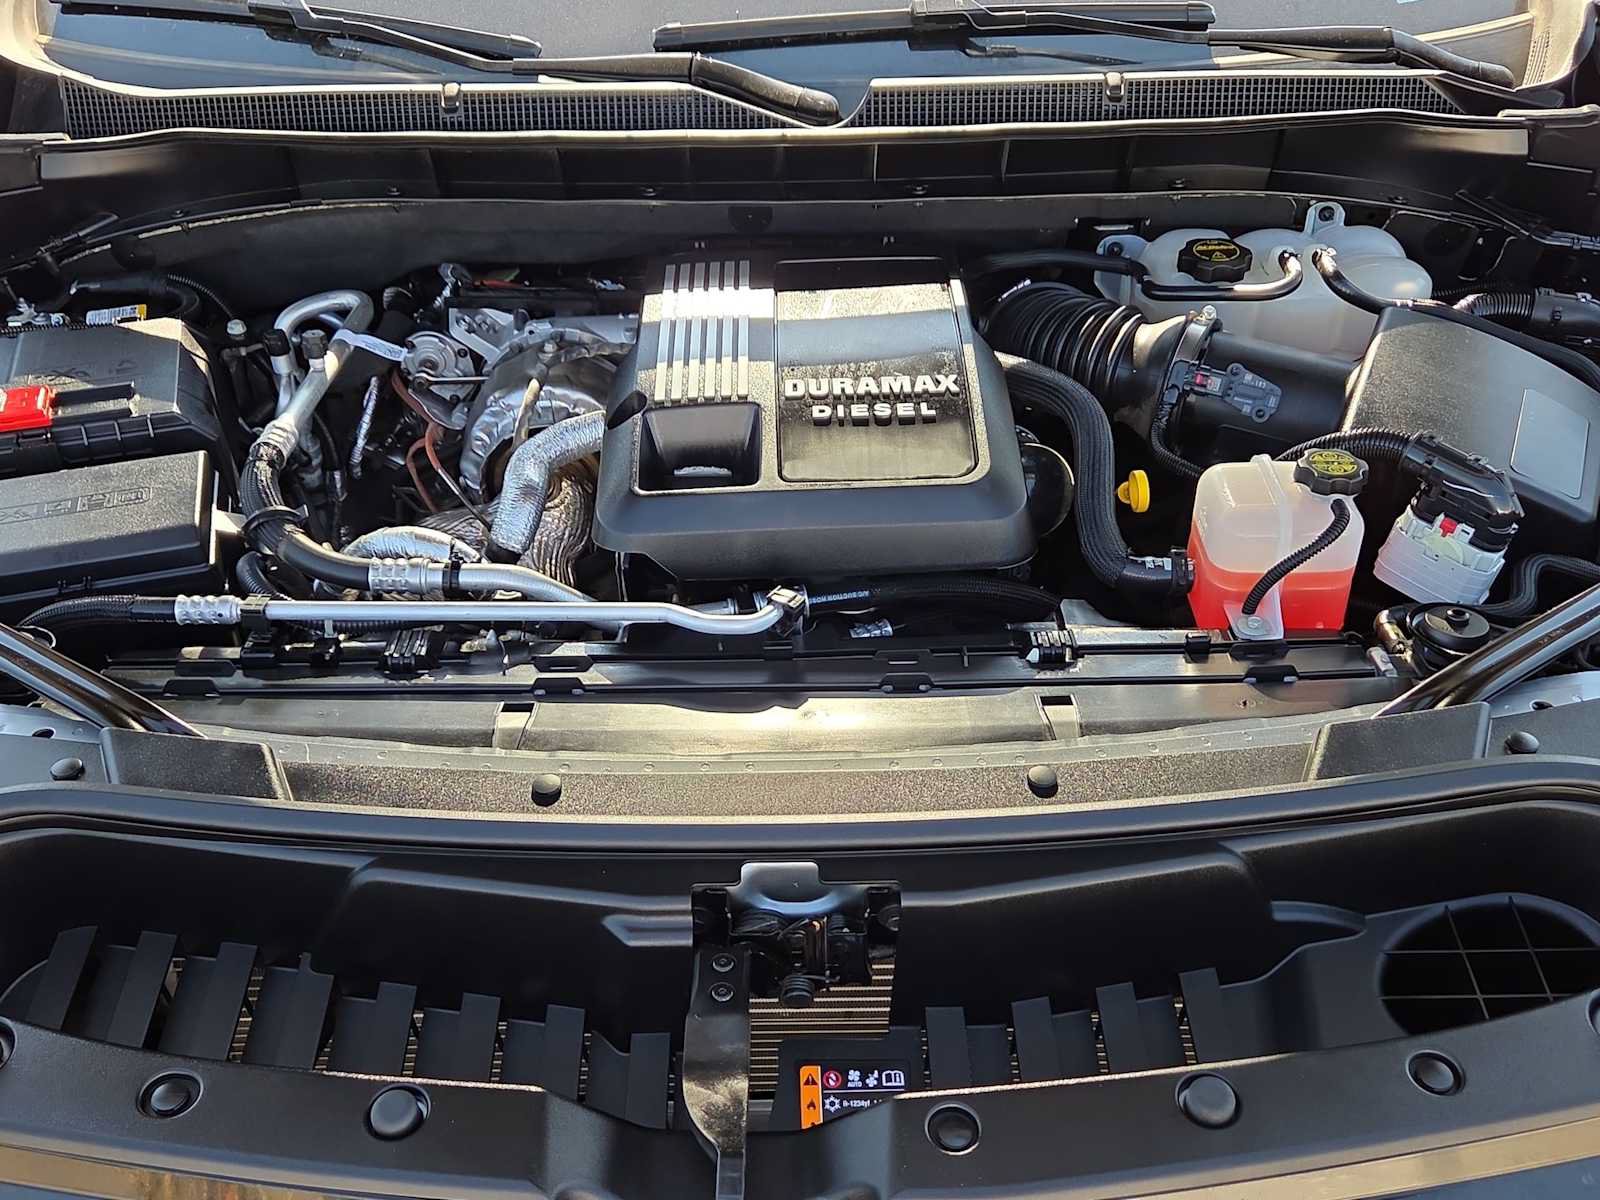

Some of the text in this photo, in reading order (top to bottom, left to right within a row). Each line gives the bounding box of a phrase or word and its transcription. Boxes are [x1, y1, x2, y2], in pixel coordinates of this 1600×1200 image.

[784, 374, 960, 398] DURAMAX
[811, 402, 937, 421] DIESEL
[827, 591, 857, 601] SUCTION
